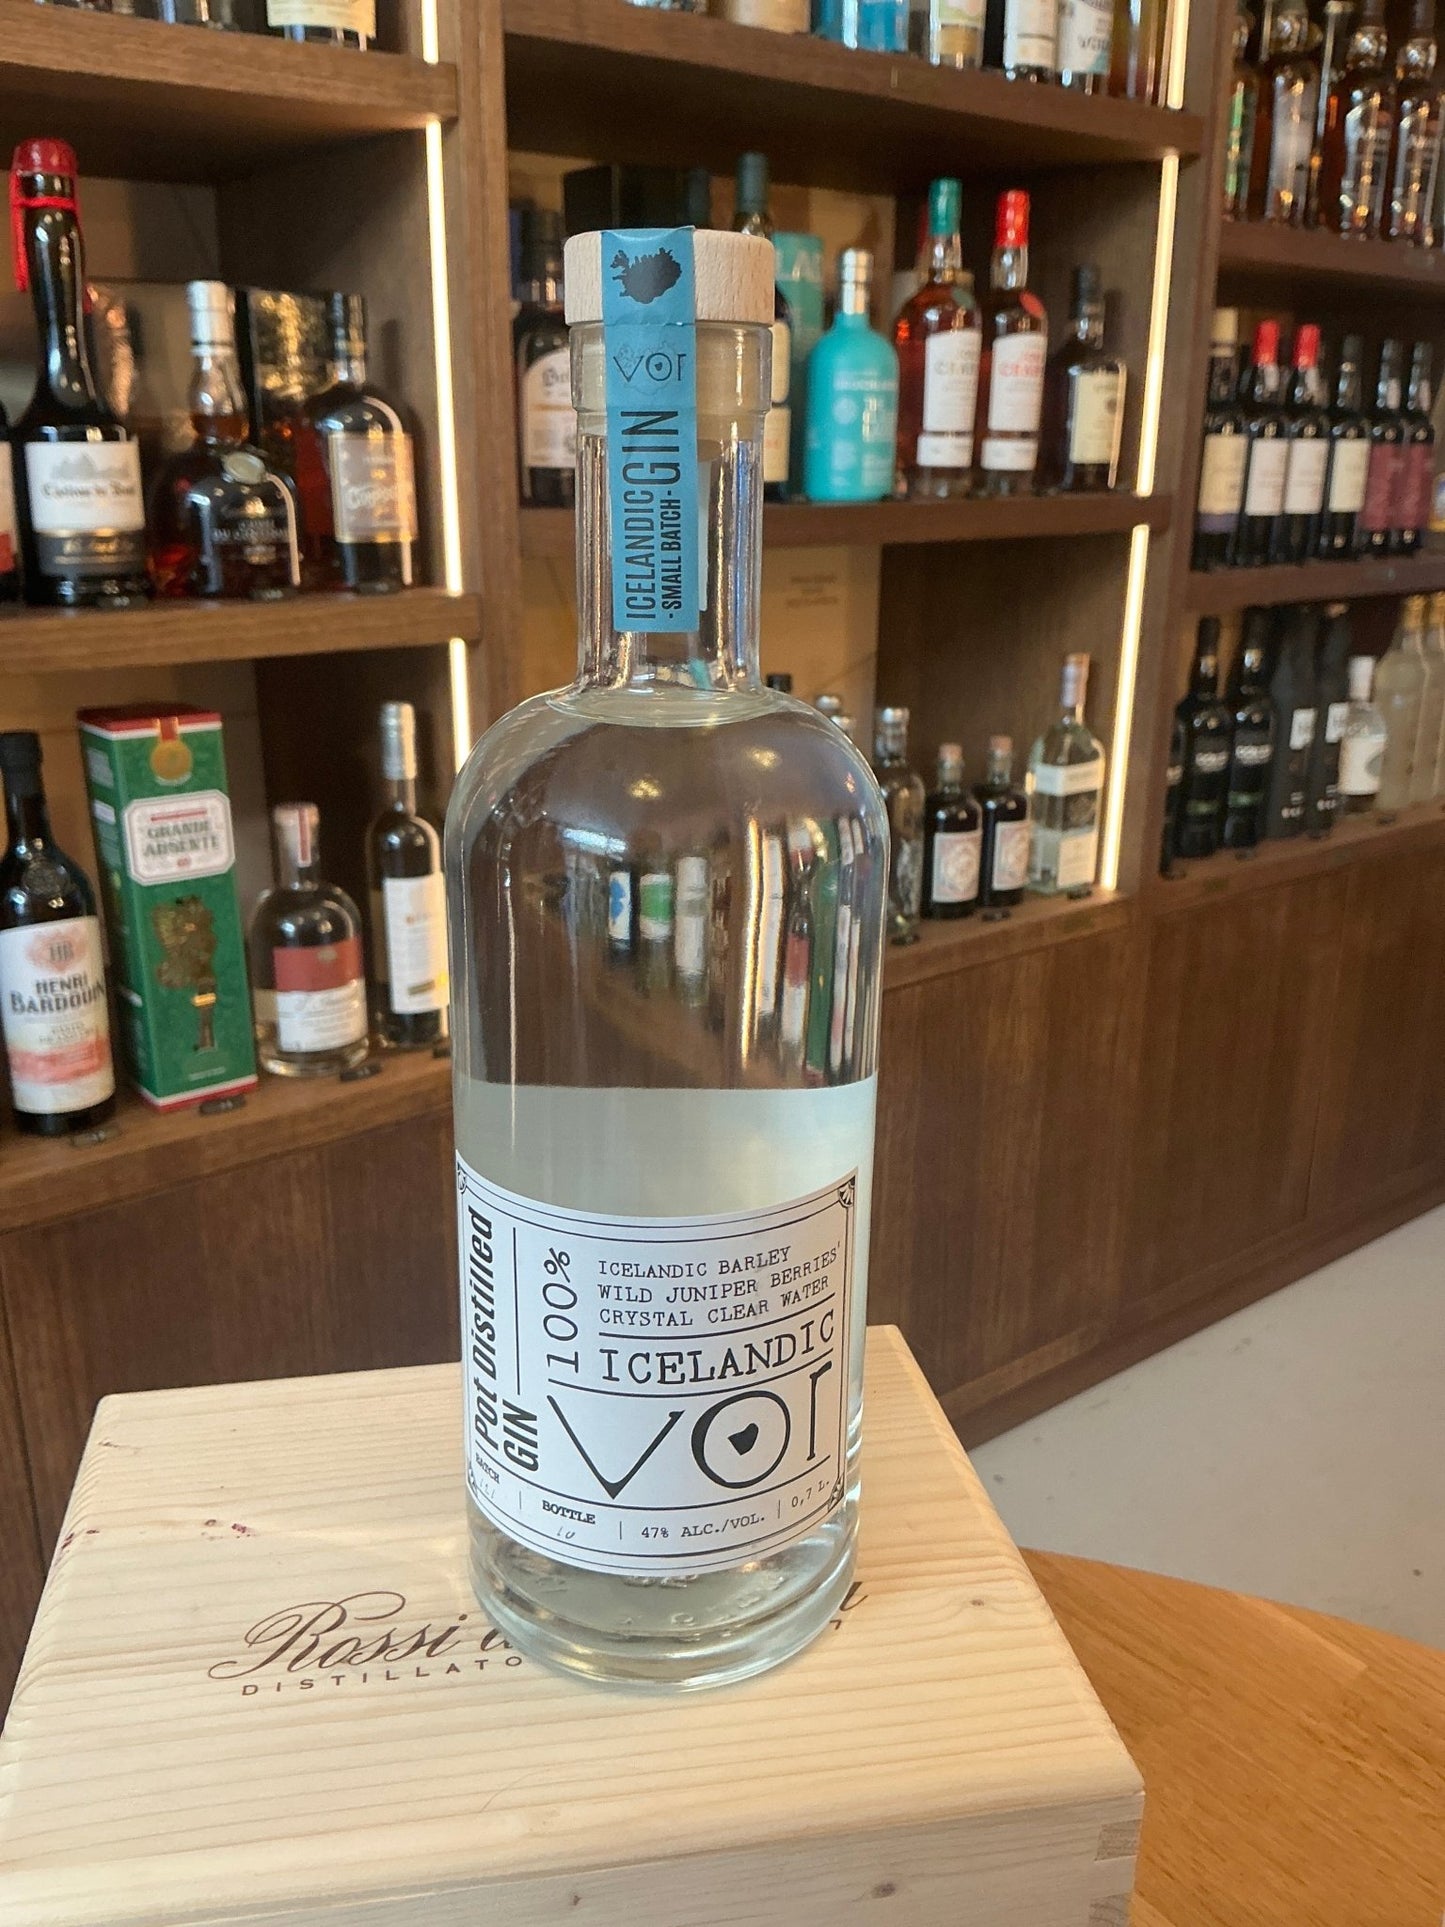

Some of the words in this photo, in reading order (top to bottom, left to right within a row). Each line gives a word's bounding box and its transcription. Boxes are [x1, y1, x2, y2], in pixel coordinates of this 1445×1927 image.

[620, 409, 682, 488] GIN
[623, 489, 656, 620] ICELANDIC
[35, 970, 89, 995] HENRI
[468, 1205, 497, 1380] Distilled
[597, 1283, 653, 1303] WILD
[665, 1279, 758, 1303] JUNIPER
[598, 1260, 707, 1279] ICELANDIC
[718, 1245, 792, 1275] BARLEY
[542, 1247, 579, 1374] 100%
[599, 1308, 693, 1327] CRYSTAL
[707, 1299, 770, 1324] CLEAR
[780, 1275, 829, 1307] WATER
[599, 1308, 834, 1384] ICELANDIC
[474, 1376, 499, 1450] Pot
[502, 1398, 539, 1472] GIN
[475, 1452, 500, 1484] BATCH
[791, 1487, 813, 1508] 0,7
[541, 1499, 596, 1525] BOTTLE
[641, 1526, 669, 1538] 47%
[680, 1514, 765, 1538] ALC./VOL.
[207, 1590, 468, 1680] Rossi
